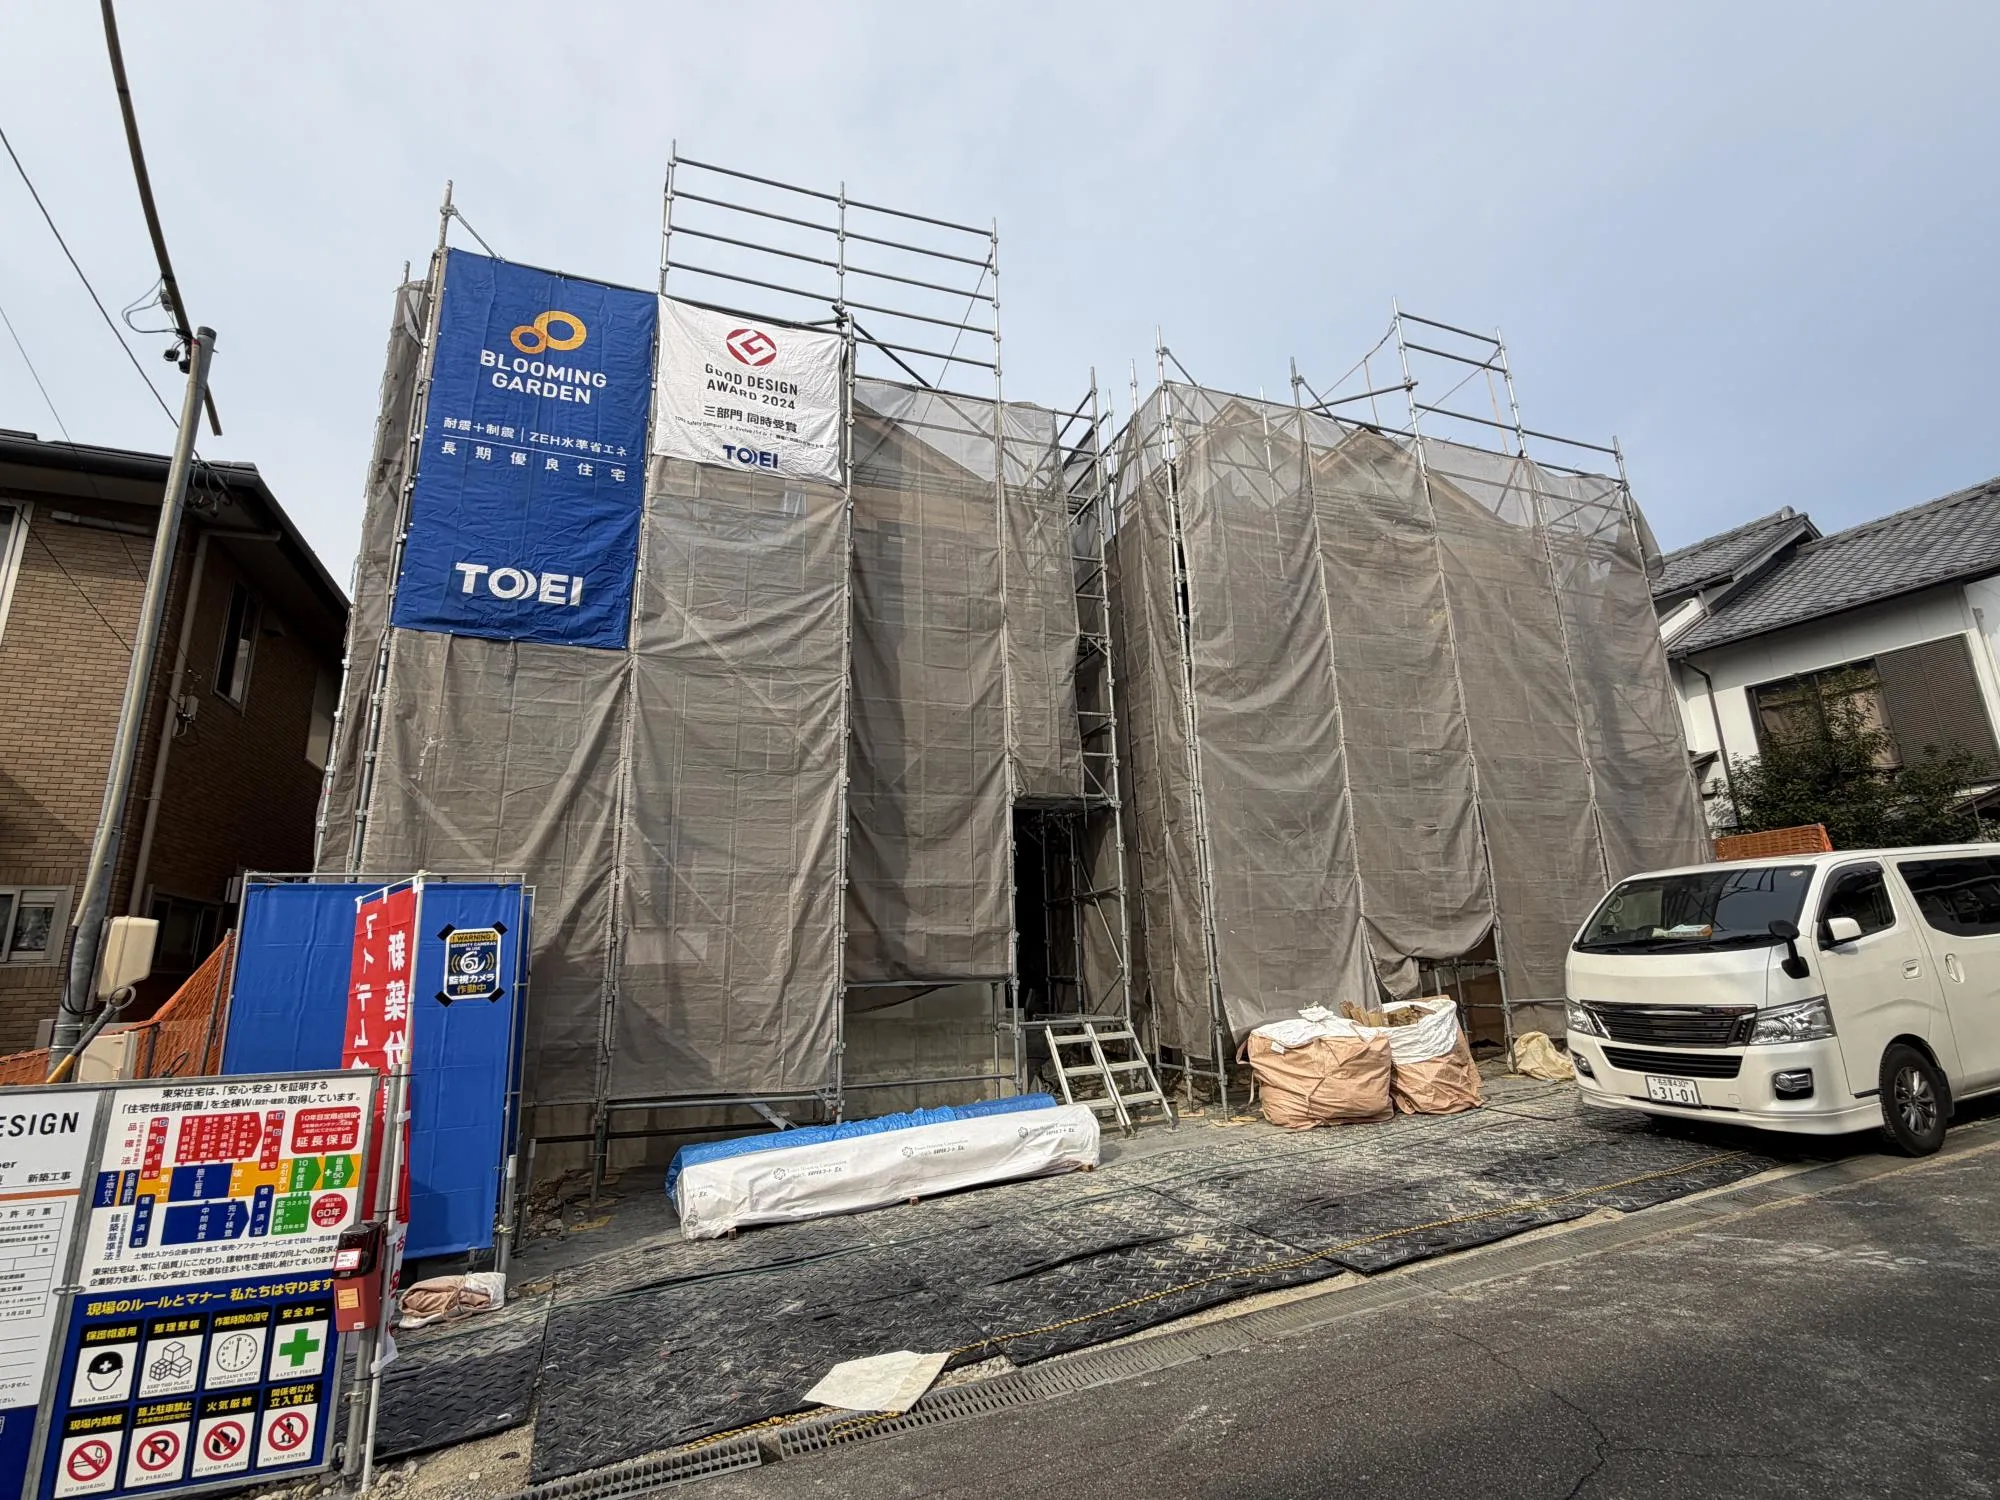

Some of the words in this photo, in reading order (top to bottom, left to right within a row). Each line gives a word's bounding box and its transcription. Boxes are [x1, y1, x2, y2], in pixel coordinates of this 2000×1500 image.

[480, 349, 607, 387] BLOOMING
[705, 363, 742, 385] GOOD
[747, 375, 798, 396] DESIGN
[491, 372, 591, 404] GARDEN
[706, 379, 757, 400] AWARD
[762, 394, 796, 410] 2024
[703, 404, 742, 421] 三部門
[746, 412, 797, 434] 同時受賞
[529, 431, 627, 457] ZEH水準省エネ
[441, 441, 627, 482] 長期優良住宅
[448, 973, 495, 985] 監視カメラ
[457, 983, 487, 994] 作動中
[295, 1133, 354, 1148] 延長保証
[28, 1171, 72, 1183] 新築工事
[296, 1160, 308, 1189] 10年保証
[103, 1174, 117, 1205] 土地仕入
[224, 1204, 237, 1237] 完了検査
[316, 1207, 341, 1218] 60年
[197, 1207, 210, 1240] 中間検査
[86, 1291, 226, 1316] 現場のルールとマナー
[230, 1278, 334, 1301] 私たちは守ります
[214, 1311, 269, 1327] 作業時間の遵守
[282, 1306, 326, 1319] 安全第一
[153, 1319, 200, 1334] 整理整頓
[275, 1370, 297, 1378] SAFETY
[98, 1393, 122, 1401] HELMET
[270, 1384, 314, 1397] 関係者以外
[206, 1396, 252, 1412] 火気厳禁
[270, 1393, 314, 1408] 立入禁止
[137, 1401, 192, 1417] 路上駐車禁止
[69, 1413, 122, 1430] 現場内禁煙
[287, 1451, 306, 1459] ENTER
[145, 1471, 173, 1481] PARKING
[75, 1482, 106, 1492] SMOKING
